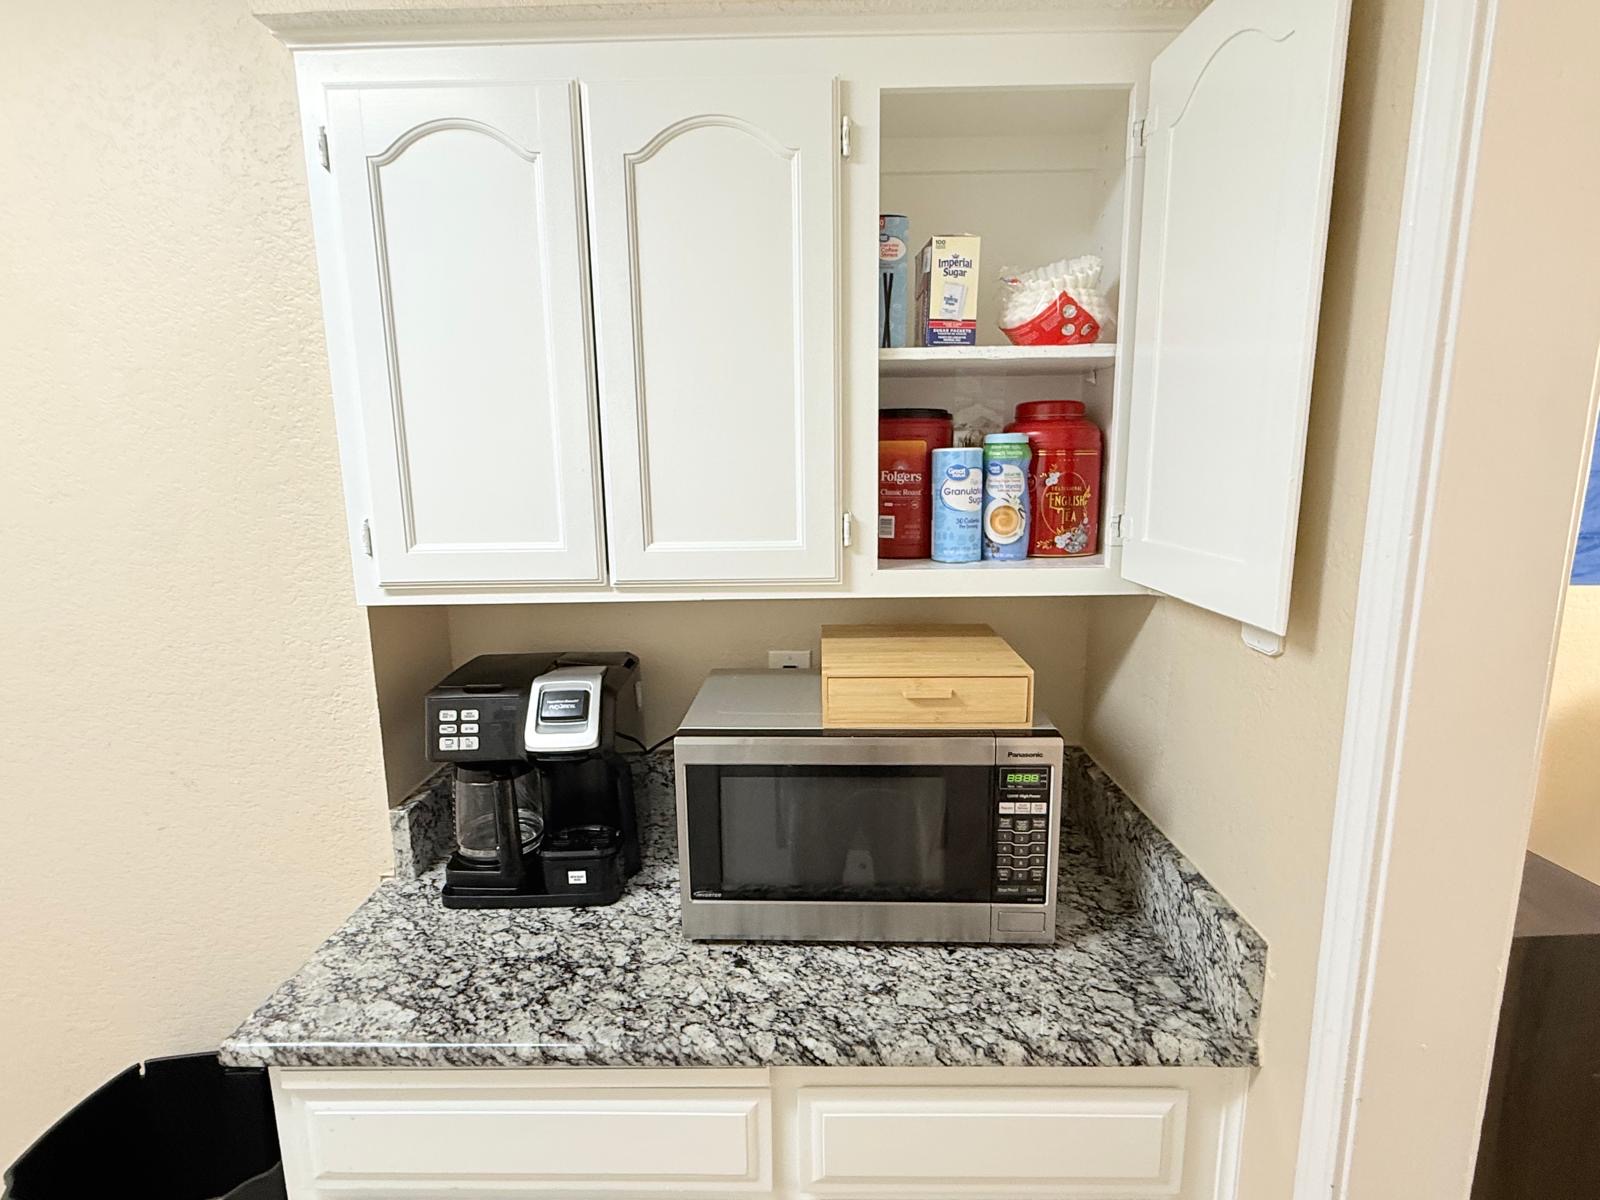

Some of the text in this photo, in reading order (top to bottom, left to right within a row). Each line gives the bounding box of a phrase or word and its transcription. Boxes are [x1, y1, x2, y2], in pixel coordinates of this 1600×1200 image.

[938, 258, 973, 269] Imperial
[943, 268, 967, 278] Sugar
[881, 471, 922, 485] Folgers
[880, 488, 922, 496] Classic Roast
[1046, 492, 1088, 508] ENGLISH
[1057, 507, 1077, 524] TEA
